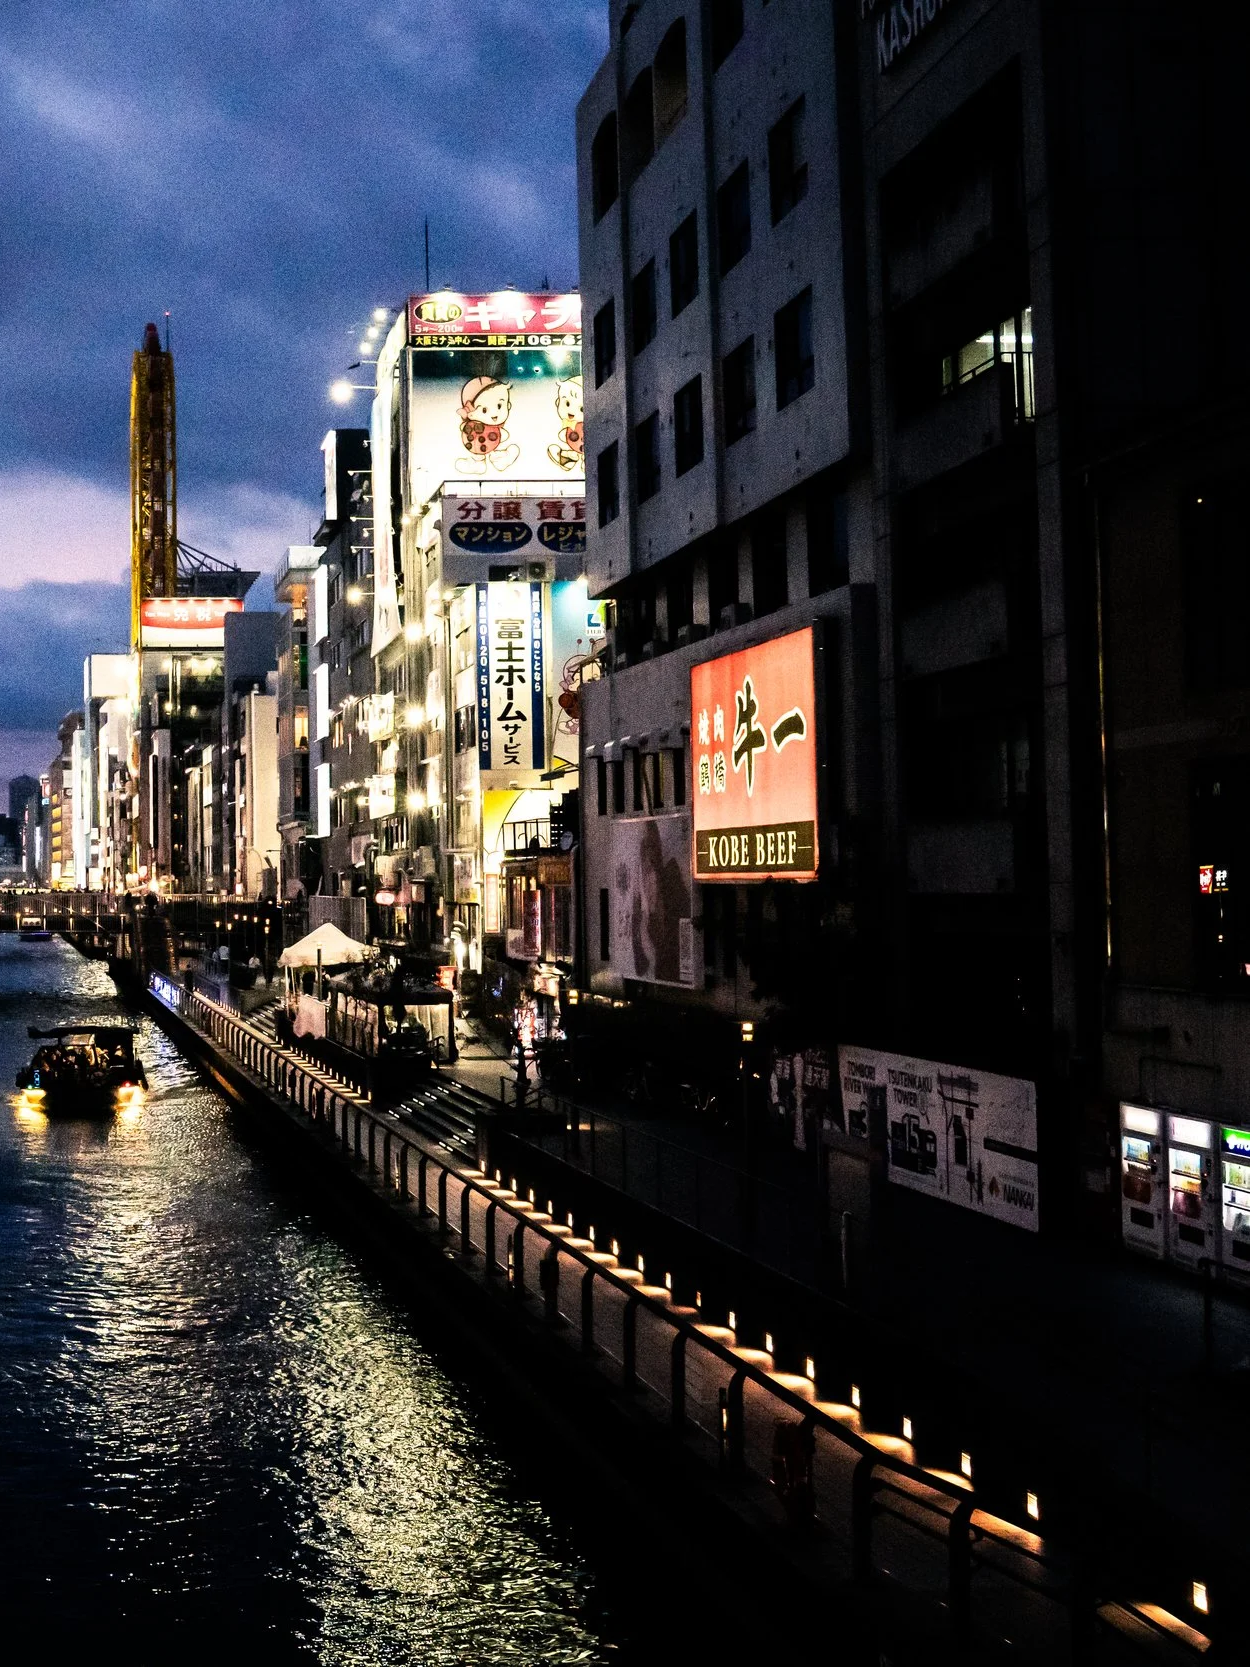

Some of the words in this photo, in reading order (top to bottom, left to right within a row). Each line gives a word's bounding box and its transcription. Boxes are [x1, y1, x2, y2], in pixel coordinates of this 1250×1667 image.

[465, 301, 581, 331] キャラ
[456, 500, 523, 521] 分譲
[454, 526, 528, 543] マンション
[495, 617, 528, 765] 富士ホームサービス
[698, 704, 725, 746] 焼肉
[731, 674, 808, 798] 牛一
[708, 833, 749, 867] KOBE
[755, 830, 797, 866] BEEF
[887, 1068, 933, 1093] TSUTENKAKU
[893, 1087, 917, 1109] TOWER
[1003, 1183, 1035, 1211] NANKAI
